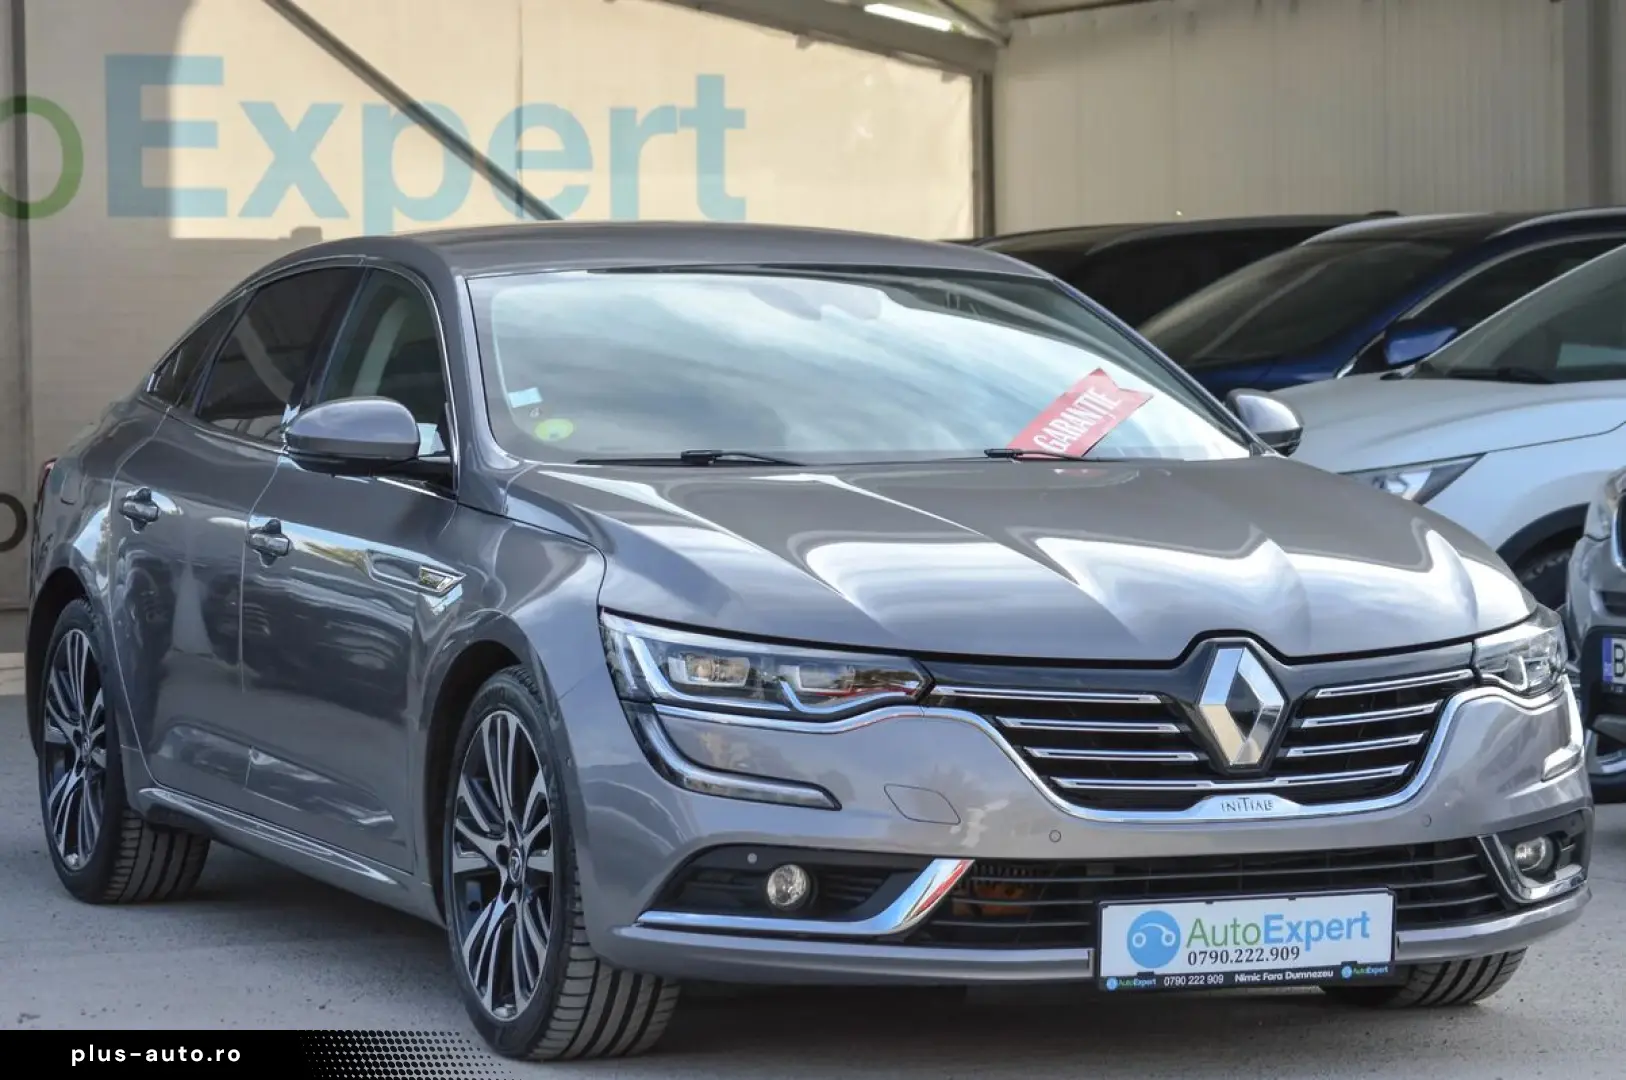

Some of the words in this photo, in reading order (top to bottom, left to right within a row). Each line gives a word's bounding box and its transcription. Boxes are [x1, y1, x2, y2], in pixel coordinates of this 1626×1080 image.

[1186, 911, 1370, 951] AutoExpert
[1187, 946, 1300, 966] 0790.222.909
[1164, 976, 1185, 986] 0790
[1188, 976, 1204, 985] 222
[1207, 974, 1224, 984] 909
[1235, 972, 1261, 982] Nimic
[1263, 971, 1282, 981] Fara
